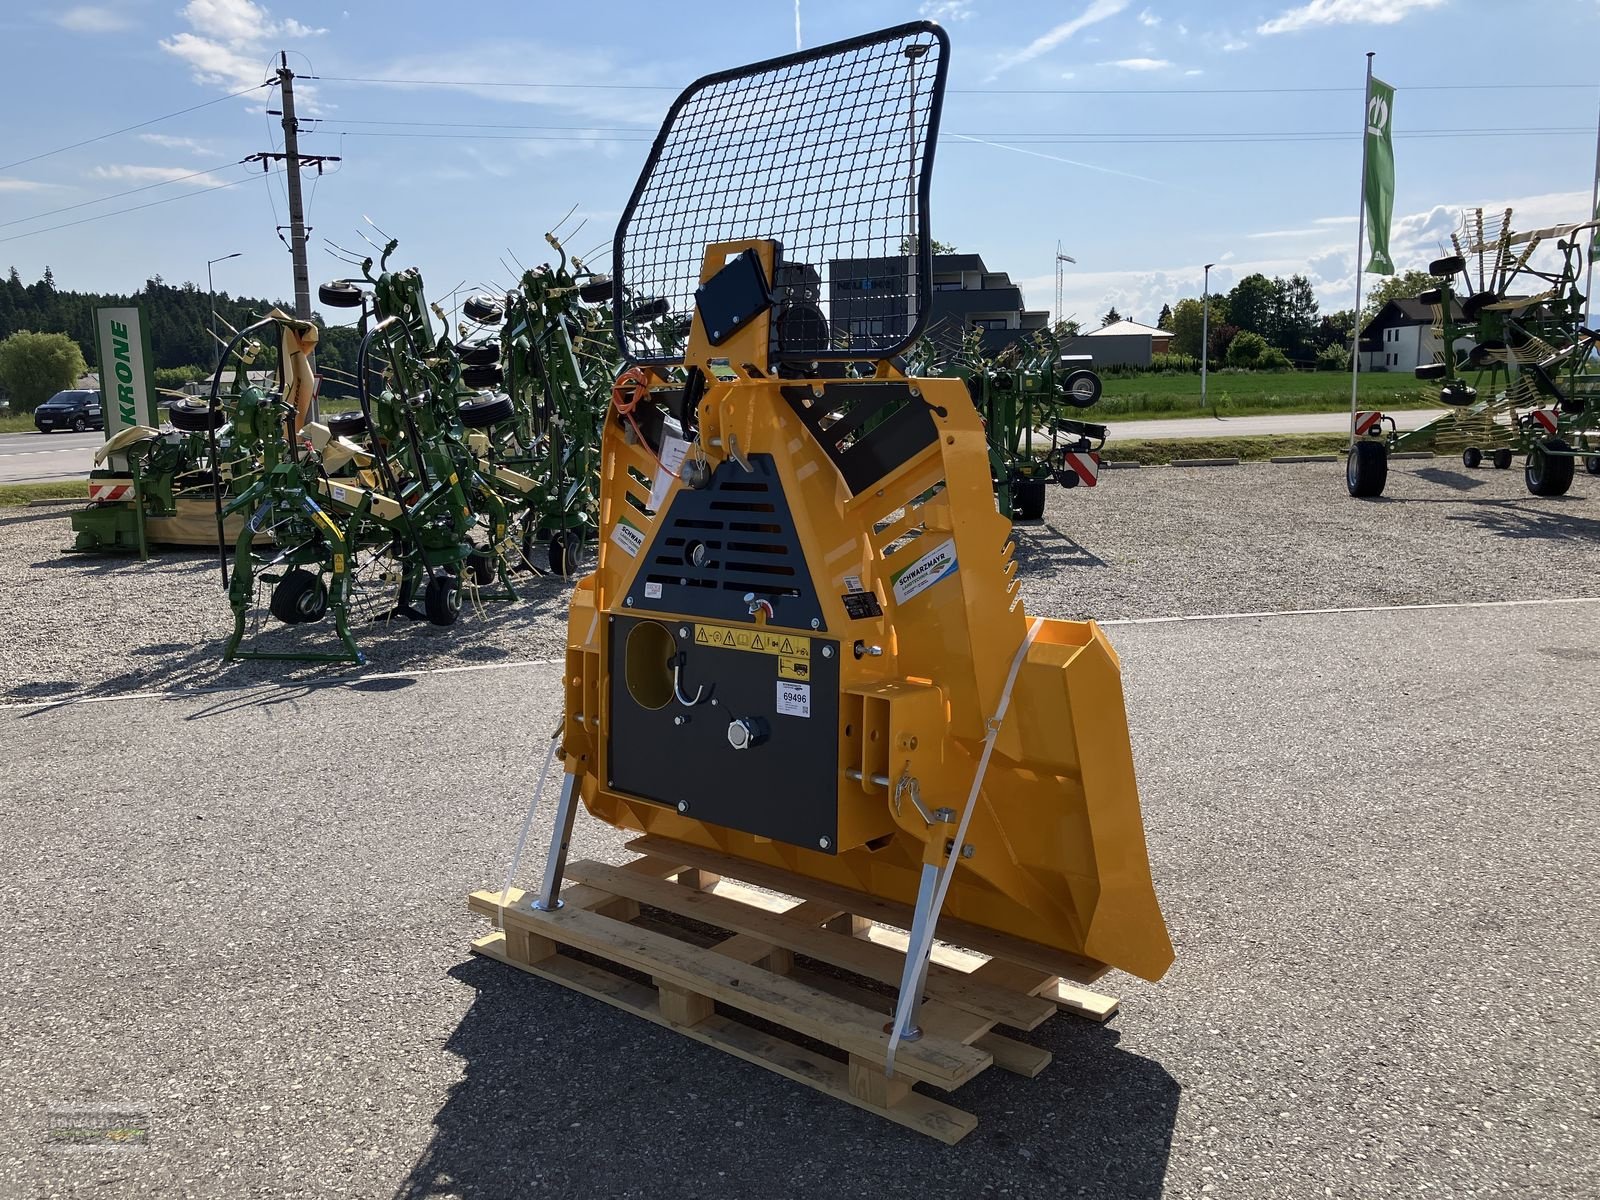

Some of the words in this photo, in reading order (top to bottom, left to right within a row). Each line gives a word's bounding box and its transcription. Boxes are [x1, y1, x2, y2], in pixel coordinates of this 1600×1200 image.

[111, 320, 136, 426] KRONE
[621, 526, 642, 546] SCHWAR
[899, 553, 946, 586] SCHWARZMAYR
[783, 692, 807, 703] 69496
